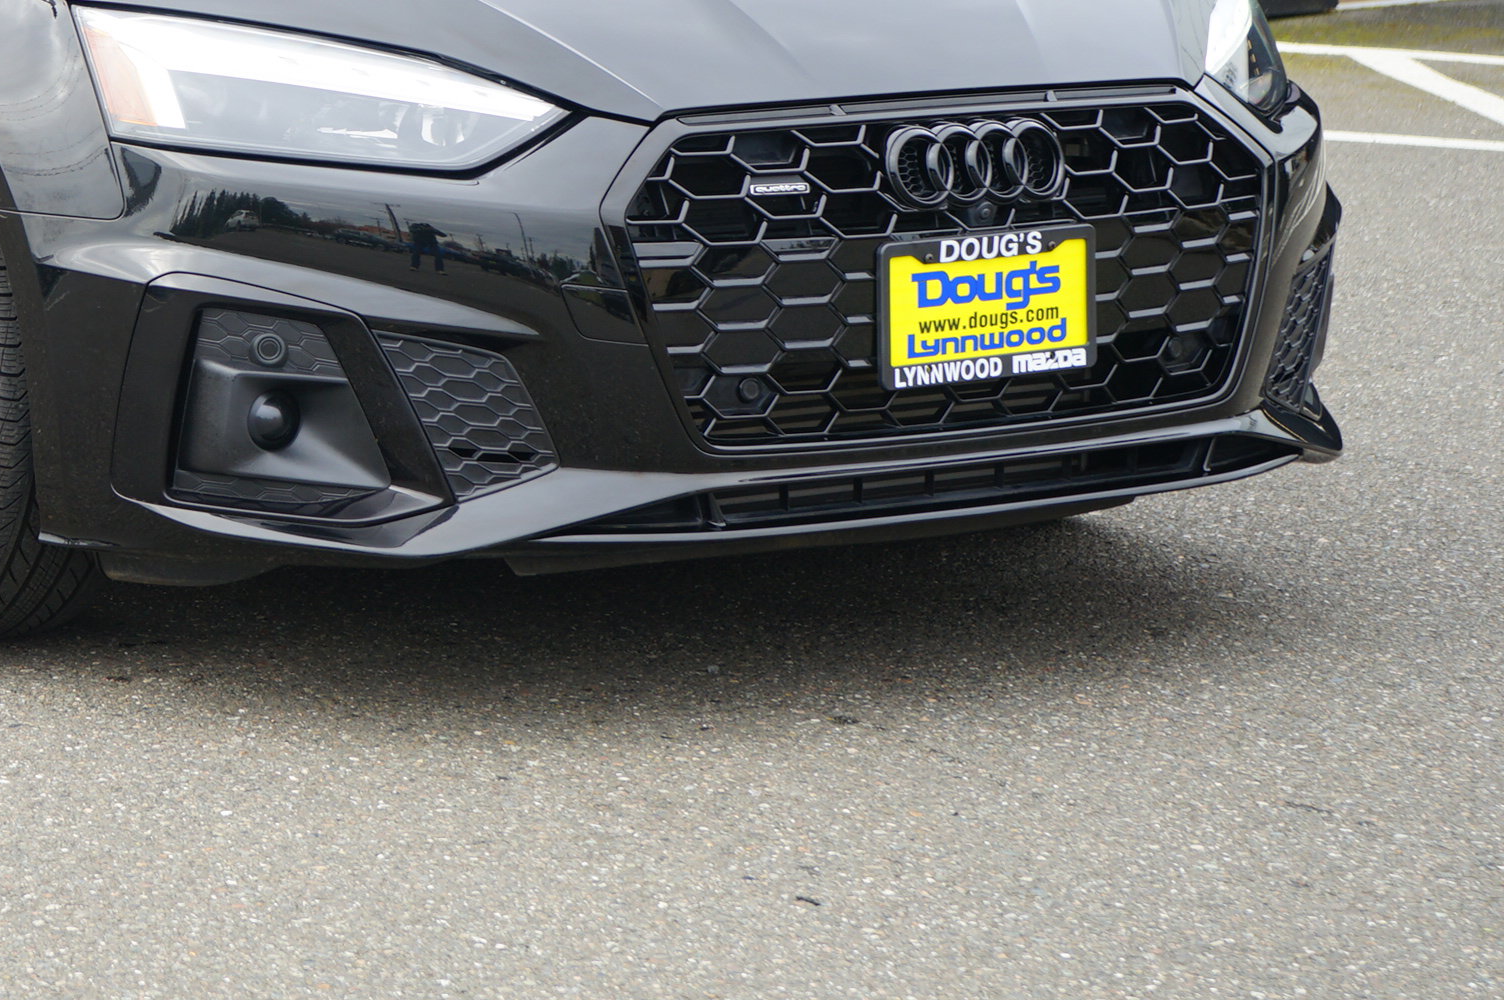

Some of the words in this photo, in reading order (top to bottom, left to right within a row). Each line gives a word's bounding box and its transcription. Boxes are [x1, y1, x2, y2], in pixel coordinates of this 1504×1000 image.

[755, 184, 806, 193] quattro
[939, 231, 1043, 263] DOUG'S
[911, 260, 1061, 311] Doug's
[918, 306, 1060, 334] www.dougs.com
[907, 317, 1067, 359] Lynnwood
[894, 357, 1003, 389] LYNNWOOD
